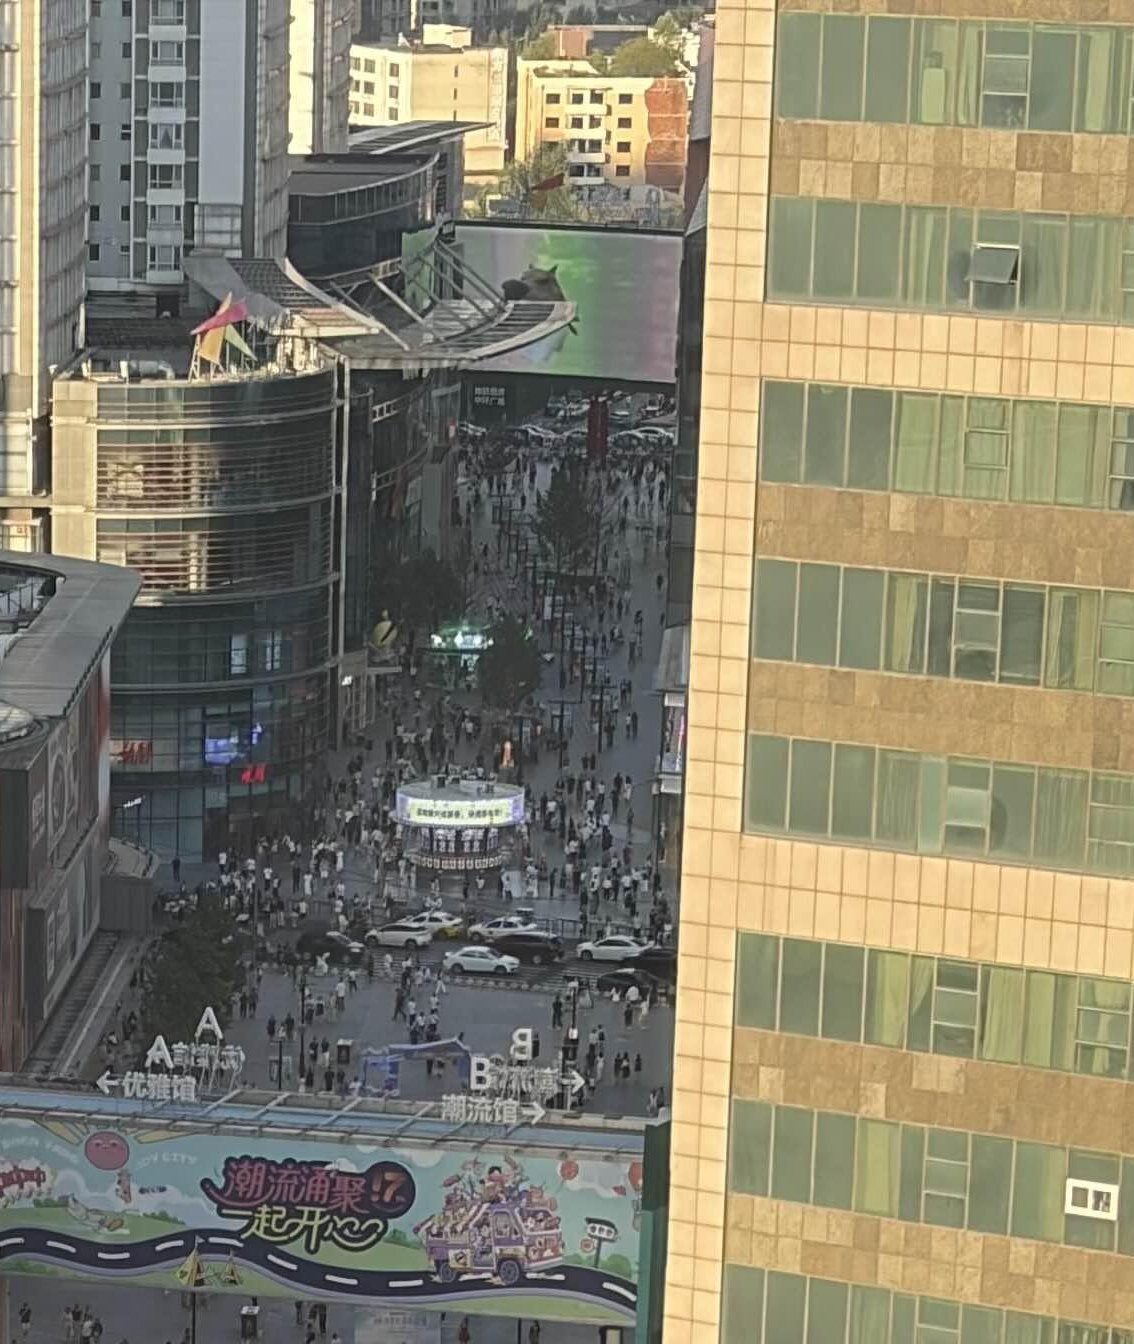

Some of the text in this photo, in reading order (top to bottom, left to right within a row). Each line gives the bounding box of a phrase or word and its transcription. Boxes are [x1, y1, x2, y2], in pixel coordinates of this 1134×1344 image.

[145, 1034, 174, 1069] A
[470, 1057, 492, 1090] B
[222, 1159, 370, 1216] 潮流涌聚
[220, 1205, 384, 1254] 一起开心
